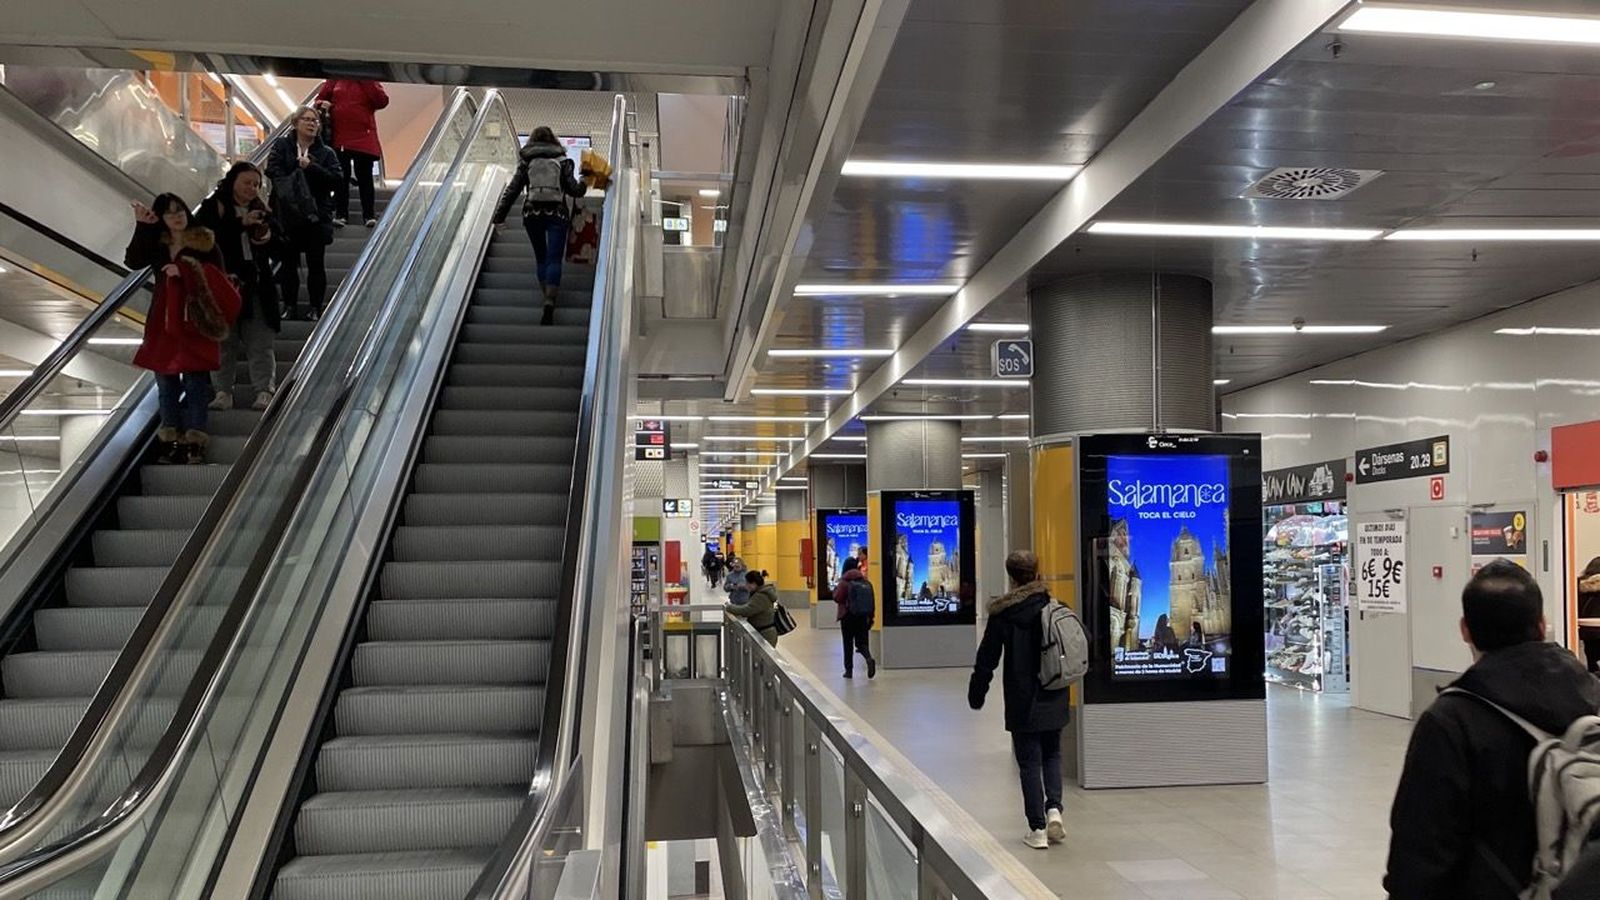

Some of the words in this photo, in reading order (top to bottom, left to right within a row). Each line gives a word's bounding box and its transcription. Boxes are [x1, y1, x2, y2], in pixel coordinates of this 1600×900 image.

[999, 358, 1020, 372] SOS
[1371, 452, 1404, 466] Dársenas
[1108, 479, 1225, 509] Salamanca
[896, 512, 958, 528] Salamanca
[1138, 511, 1160, 519] TOCA
[1162, 511, 1172, 519] EL
[1173, 511, 1196, 519] CIELO
[1374, 535, 1402, 544] TEMPORADA
[1361, 558, 1376, 581] 6€
[1382, 557, 1403, 584] 9€
[1368, 579, 1390, 598] 15€
